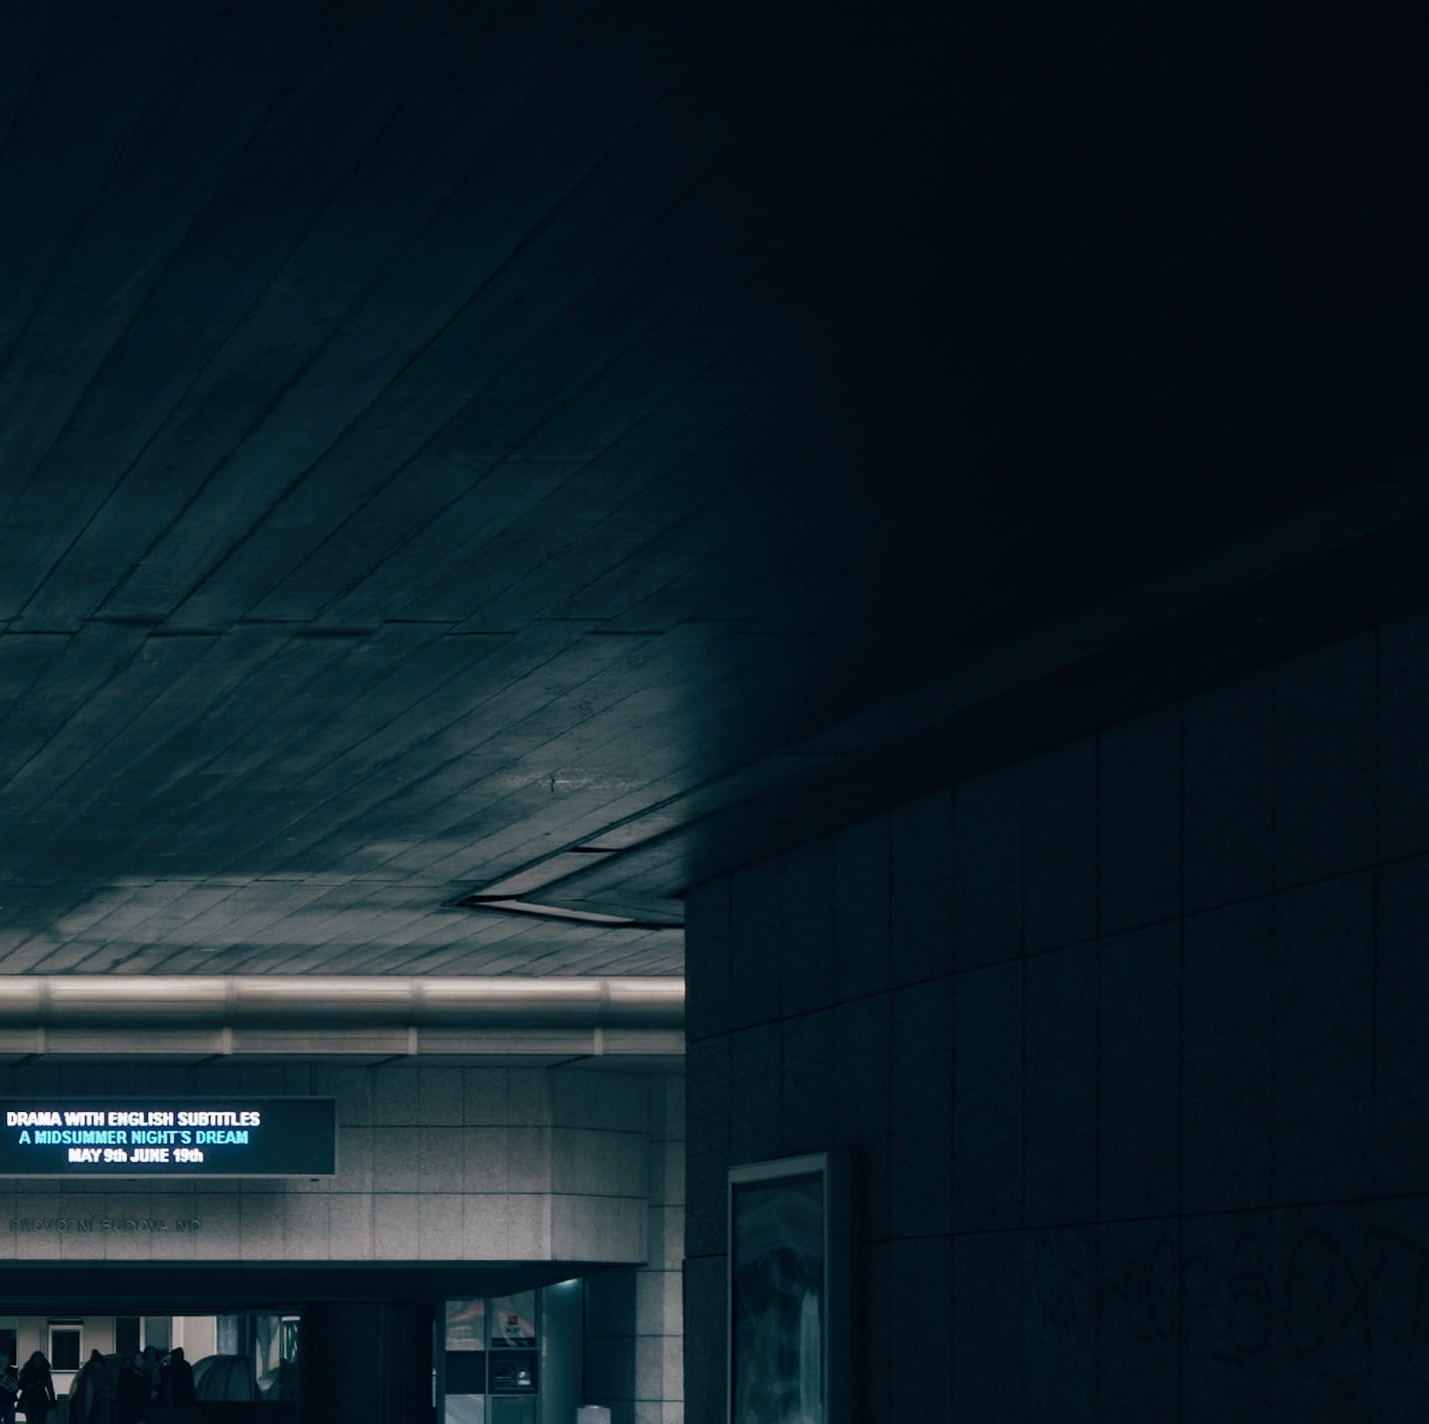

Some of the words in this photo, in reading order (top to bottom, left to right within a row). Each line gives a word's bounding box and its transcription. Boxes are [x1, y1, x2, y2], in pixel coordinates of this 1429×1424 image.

[7, 1111, 62, 1127] DRAMA
[64, 1111, 105, 1127] WITH
[107, 1111, 175, 1127] ENGLISH
[177, 1111, 261, 1127] SUBTITLES
[18, 1130, 31, 1145] A
[34, 1130, 128, 1145] MIDSUMMER
[131, 1130, 191, 1145] NIGHT'S
[195, 1130, 249, 1145] DREAM
[68, 1148, 102, 1163] MAY
[103, 1148, 127, 1163] 9th
[129, 1148, 170, 1163] JUNE
[172, 1148, 204, 1163] 19th
